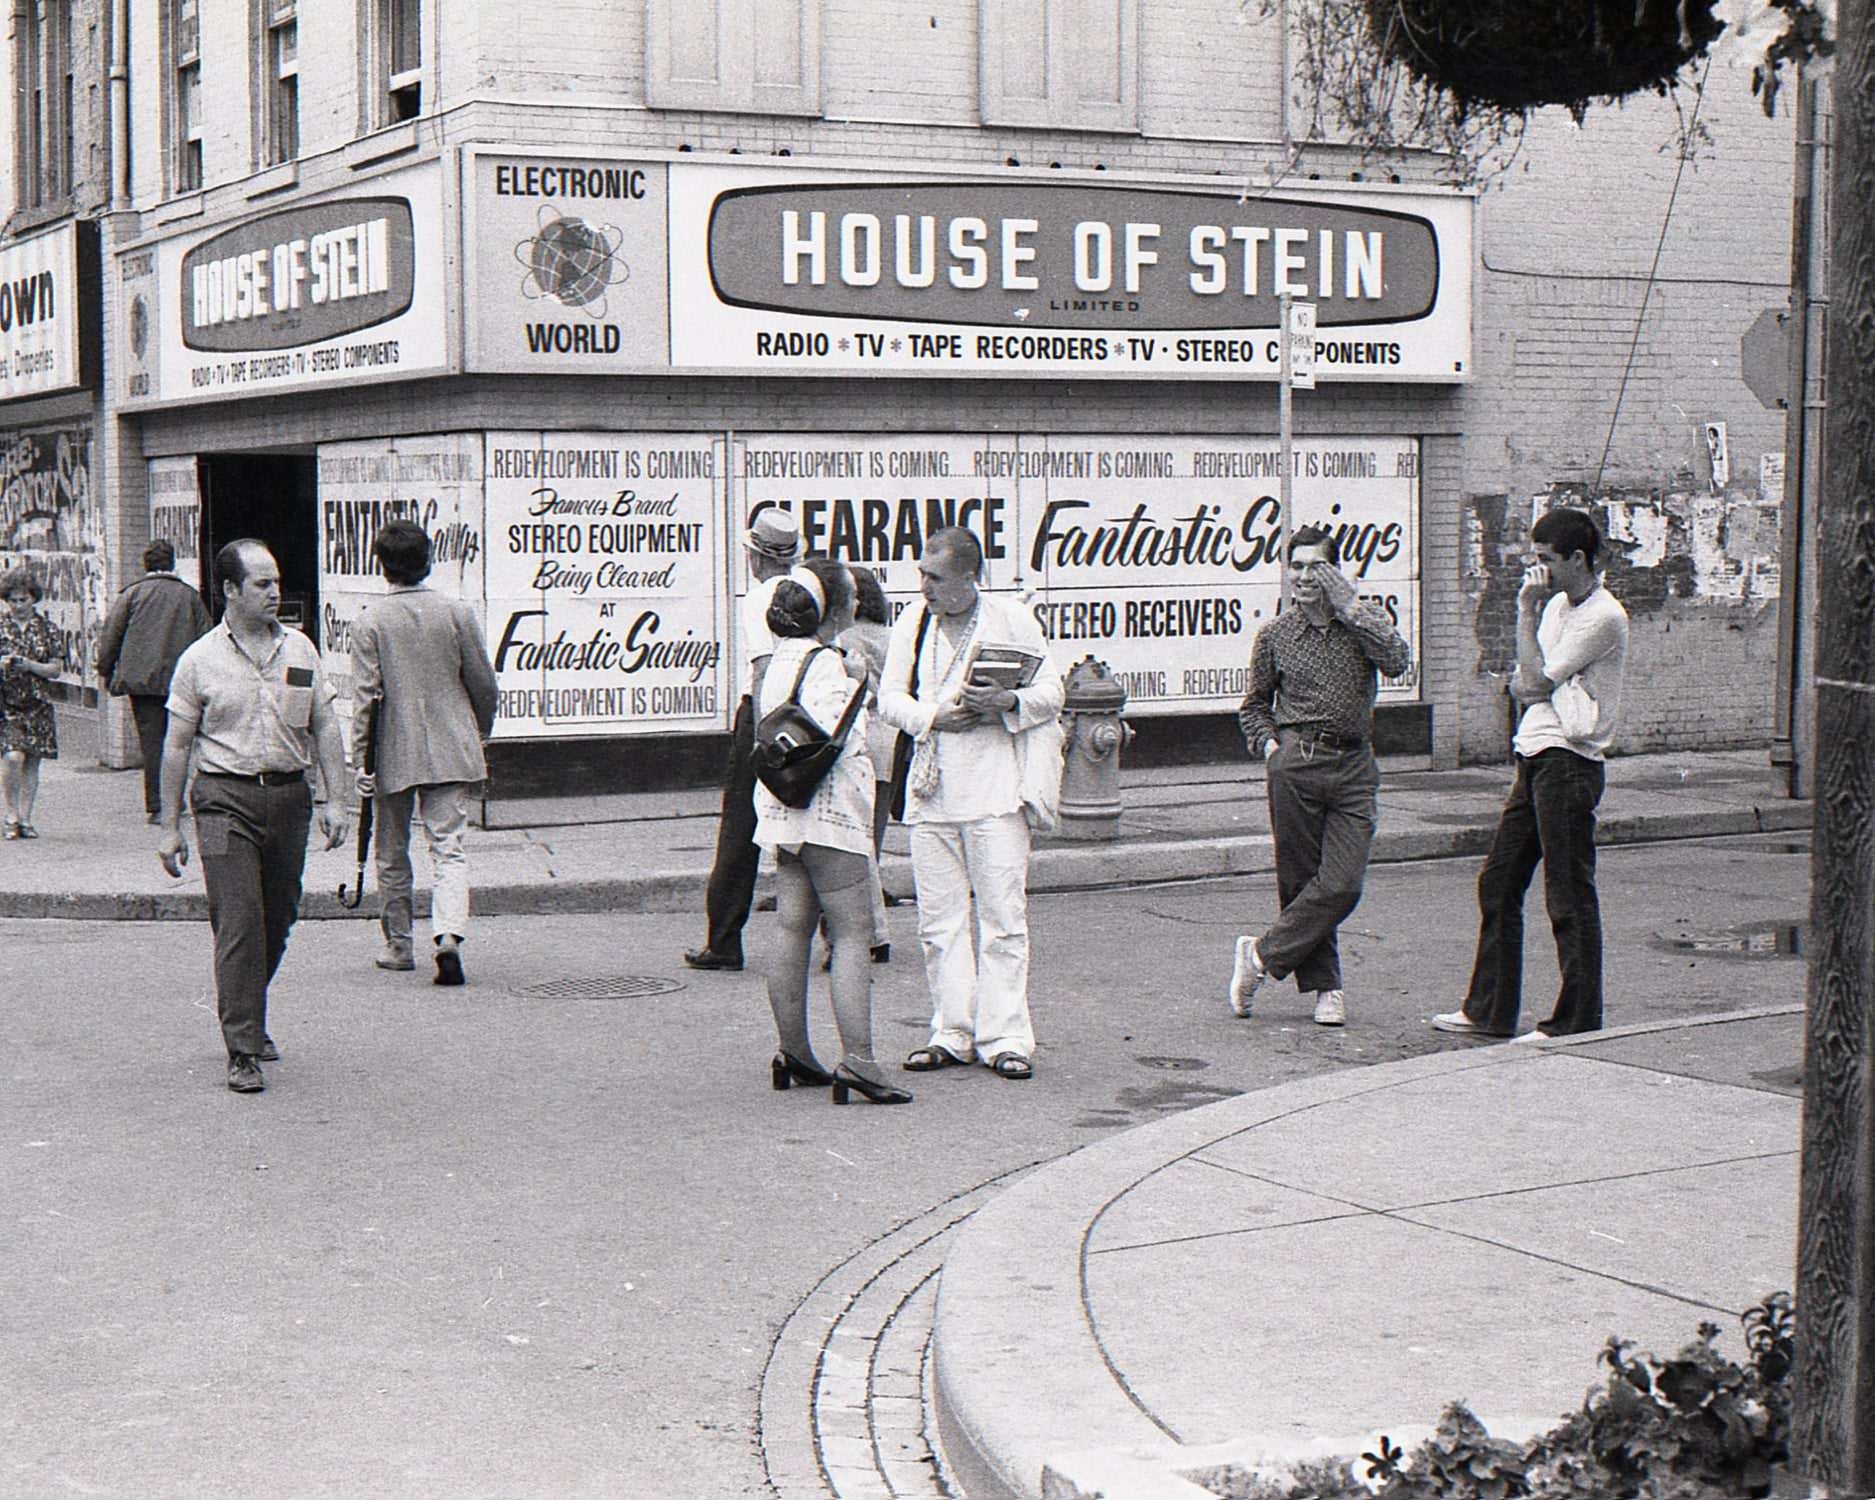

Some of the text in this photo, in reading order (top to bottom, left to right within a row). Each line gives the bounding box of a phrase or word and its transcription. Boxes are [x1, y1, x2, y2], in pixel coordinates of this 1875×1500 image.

[496, 166, 645, 199] ELECTRONIC
[782, 211, 1383, 299] HOUSE OF STEIN
[193, 218, 390, 327] HOUSE OF STEIN
[1050, 301, 1140, 312] LIMITED
[526, 323, 621, 355] WORLD
[757, 333, 829, 356] RADIO
[855, 334, 884, 357] TV
[908, 335, 962, 358] TAPE
[977, 336, 1108, 360] RECORDERS
[1129, 340, 1155, 361] TV
[1177, 340, 1254, 362] STEREO
[1266, 341, 1401, 365] CPONENTS
[250, 354, 290, 380] RECORDERS
[312, 347, 341, 372] STEREO
[344, 340, 400, 368] COMPONENTS
[495, 449, 619, 478] REDEVELOPMENT
[625, 449, 641, 478] IS
[648, 449, 713, 478] COMING
[745, 451, 863, 478] REDEVELOPMENT
[869, 451, 884, 478] IS
[974, 451, 1093, 478] REDEVELOPMENT
[1099, 452, 1111, 478] IS
[1193, 451, 1301, 478] REDEVELOPMET
[1305, 452, 1319, 478] IS
[528, 488, 678, 517] Famous Brand
[509, 523, 702, 553] STEREO EQUIPMENT
[1031, 496, 1402, 579] Fantastic Saings
[533, 560, 675, 594] Being Cleared
[600, 603, 615, 618] AT
[1034, 603, 1116, 640] STEREO
[1126, 599, 1242, 637] RECEIVERS
[494, 610, 720, 682] Fantastic Savings
[499, 687, 715, 719] REDEVELOPMENT IS COMING
